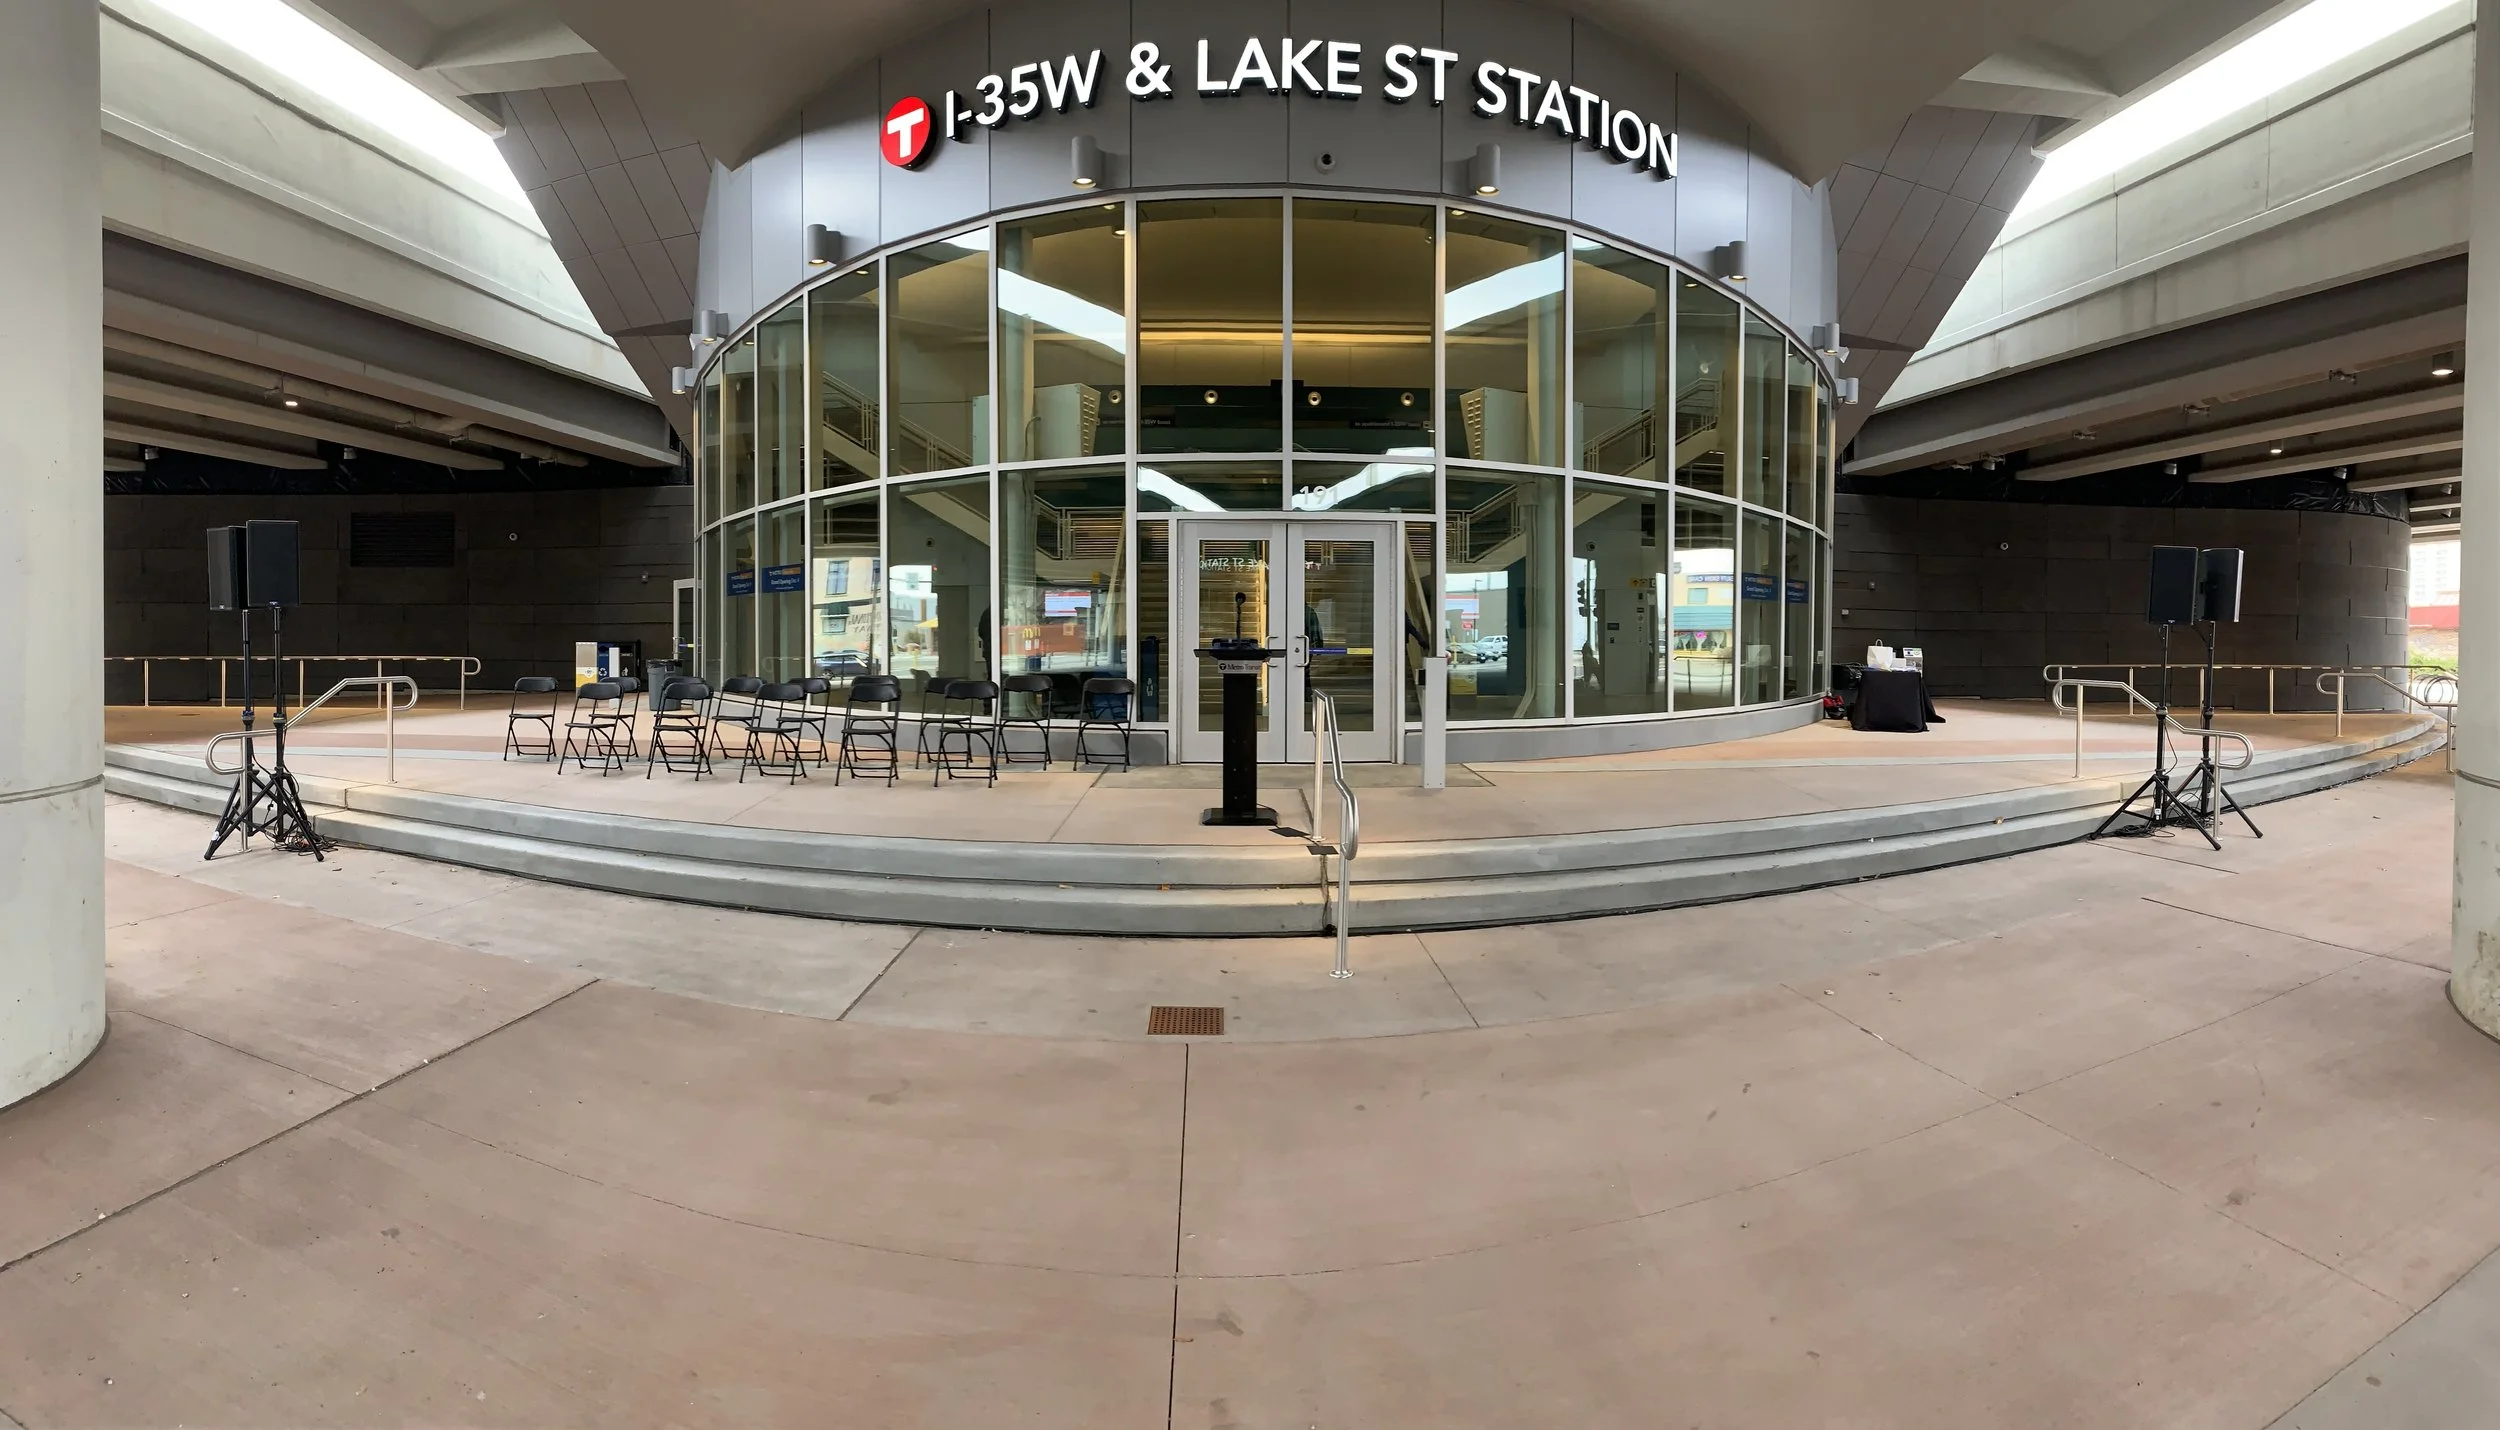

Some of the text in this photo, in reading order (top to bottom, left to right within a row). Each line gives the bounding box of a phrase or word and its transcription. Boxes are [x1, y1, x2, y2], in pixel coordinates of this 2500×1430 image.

[945, 49, 1101, 138] I-35W
[1125, 42, 1172, 96] &
[1197, 38, 1362, 95] LAKE
[1384, 44, 1458, 101] ST
[1476, 61, 1678, 177] STATION
[1299, 485, 1338, 505] 191
